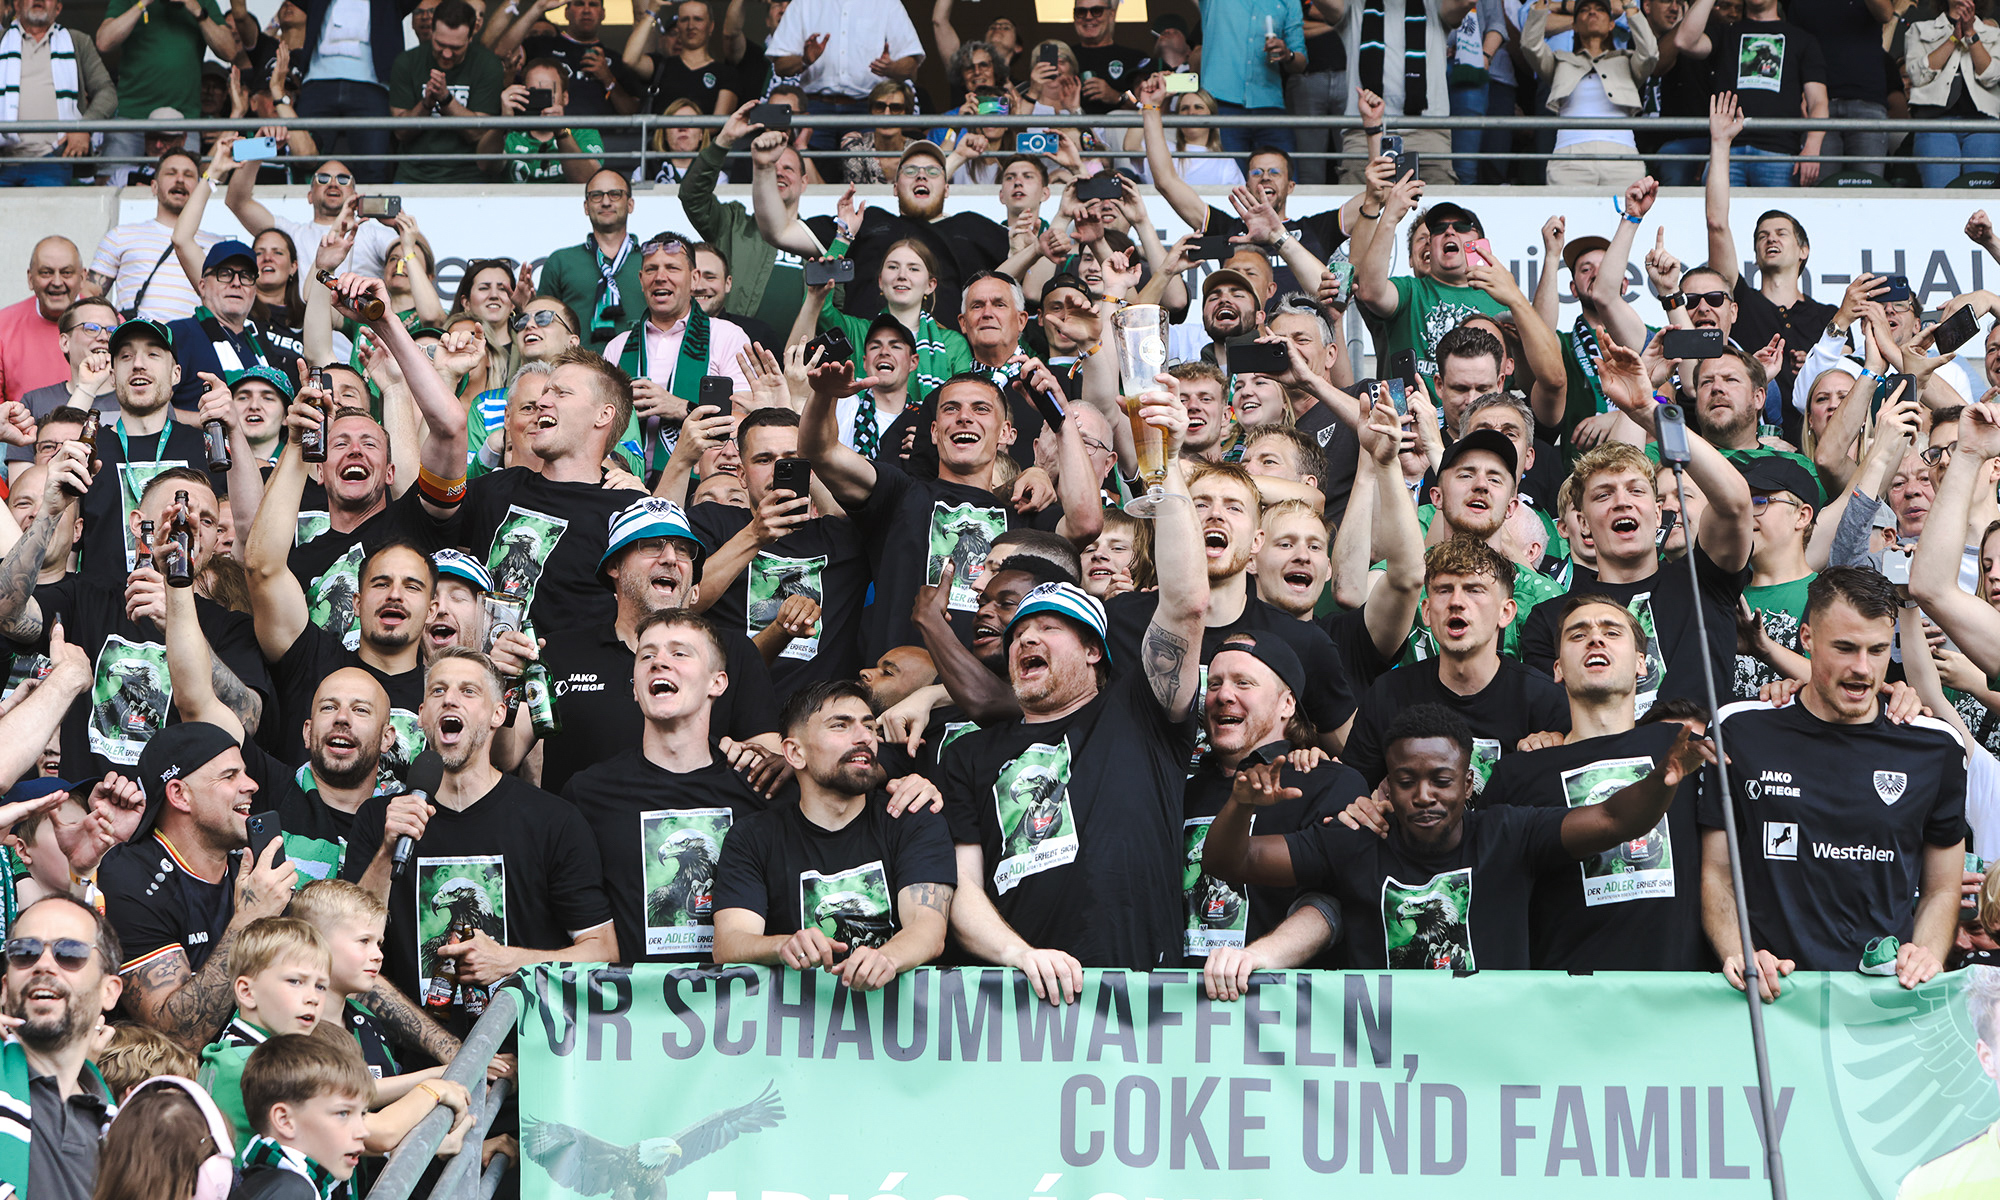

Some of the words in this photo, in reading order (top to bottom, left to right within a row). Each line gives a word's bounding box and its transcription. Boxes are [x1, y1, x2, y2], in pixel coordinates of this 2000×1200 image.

[1838, 178, 1873, 186] goracon
[568, 673, 598, 682] JAKO
[571, 683, 606, 692] FIEGE
[1760, 770, 1793, 784] JAKO
[1764, 785, 1801, 798] FIEGE
[1812, 842, 1895, 862] Westfalen
[1587, 887, 1601, 897] DER
[1603, 880, 1635, 893] ADLER
[648, 937, 662, 945] DER
[664, 932, 696, 944] ADLER
[662, 969, 1419, 1083] SCHAUMWAFFELN,
[1060, 1073, 1271, 1169] COKE
[1303, 1079, 1469, 1177] UND
[1500, 1083, 1796, 1180] FAMILY
